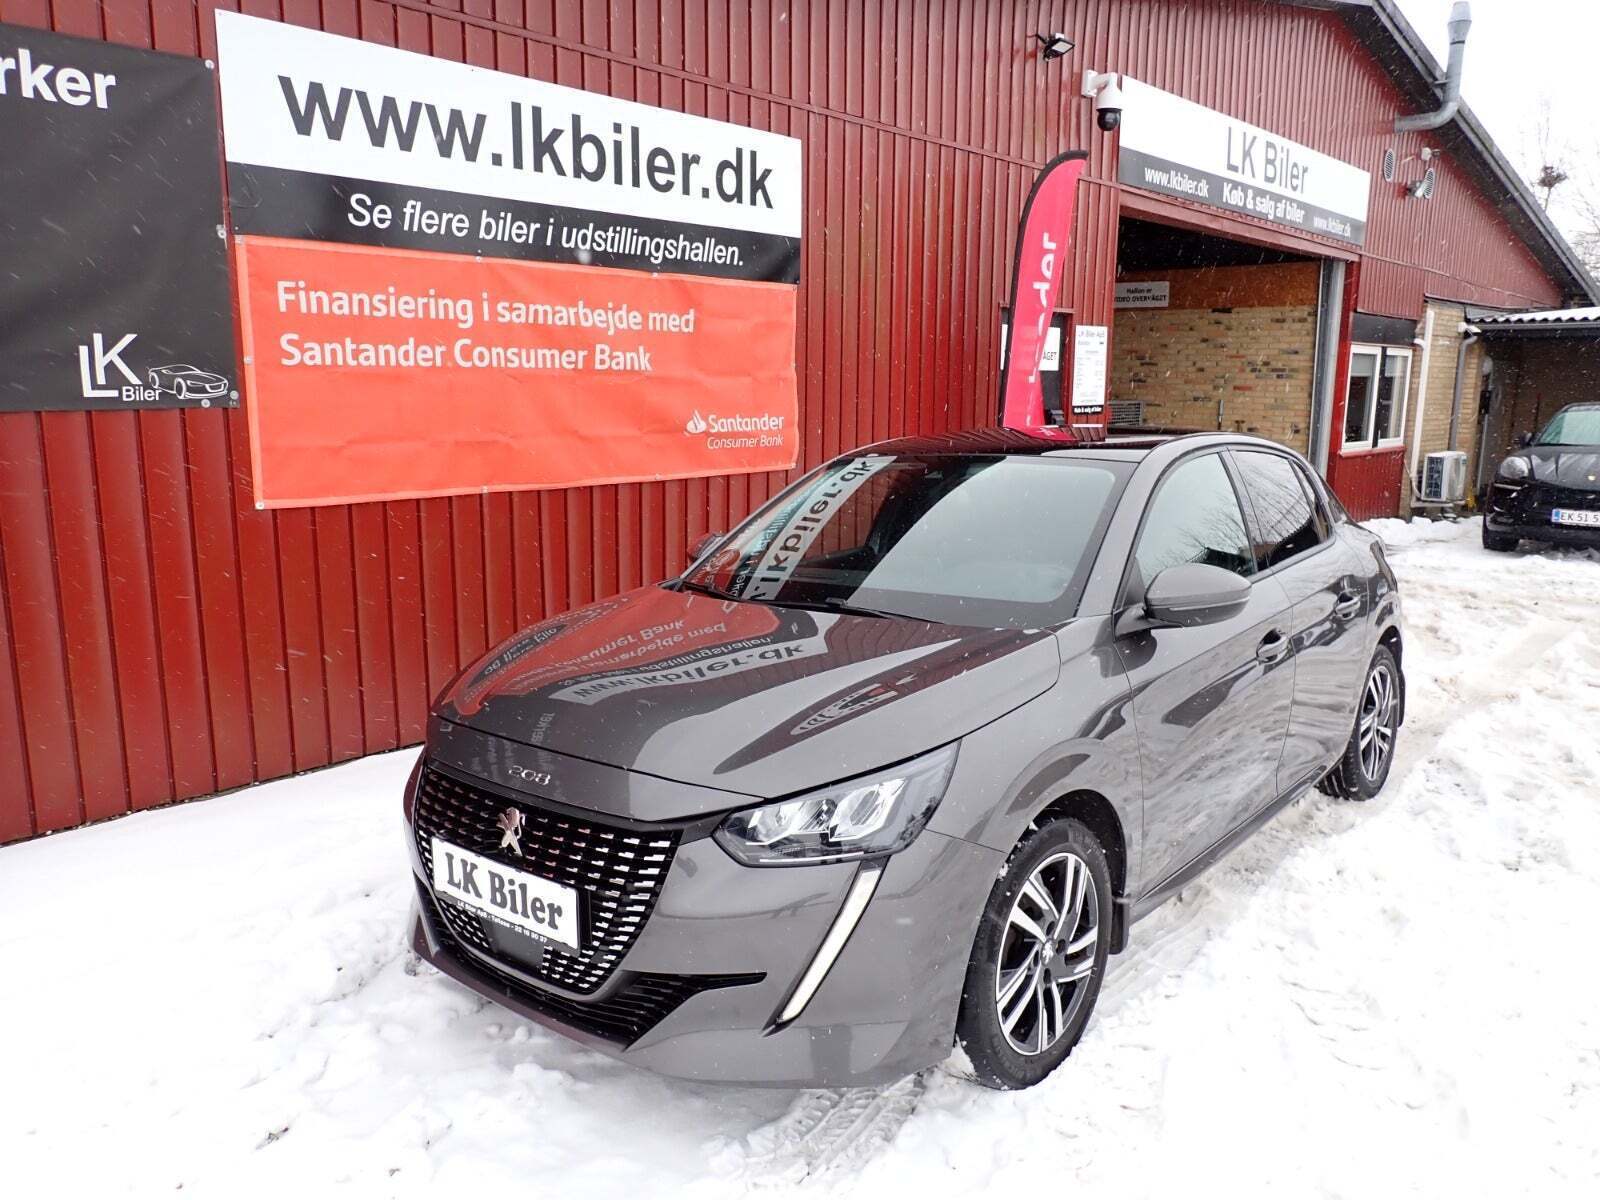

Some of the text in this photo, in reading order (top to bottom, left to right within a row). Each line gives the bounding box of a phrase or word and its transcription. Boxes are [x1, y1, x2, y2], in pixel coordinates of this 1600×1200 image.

[278, 75, 774, 209] www.lkbiler.dk
[1225, 126, 1309, 194] LK Biler
[1144, 166, 1209, 198] www.lkbiler.dk
[1222, 182, 1305, 224] Køb & salg af biler
[348, 193, 744, 267] Se flere biler i udstillingshallen.
[276, 281, 696, 335] Finansiering i samarbejde med
[79, 333, 142, 398] LK
[280, 334, 653, 372] Santander Consumer Bank
[122, 386, 163, 401] Biler
[707, 434, 784, 449] Consumer Bank
[708, 414, 784, 433] Santander
[1561, 512, 1574, 521] EK
[508, 765, 551, 786] 208
[445, 852, 563, 930] LK Biler
